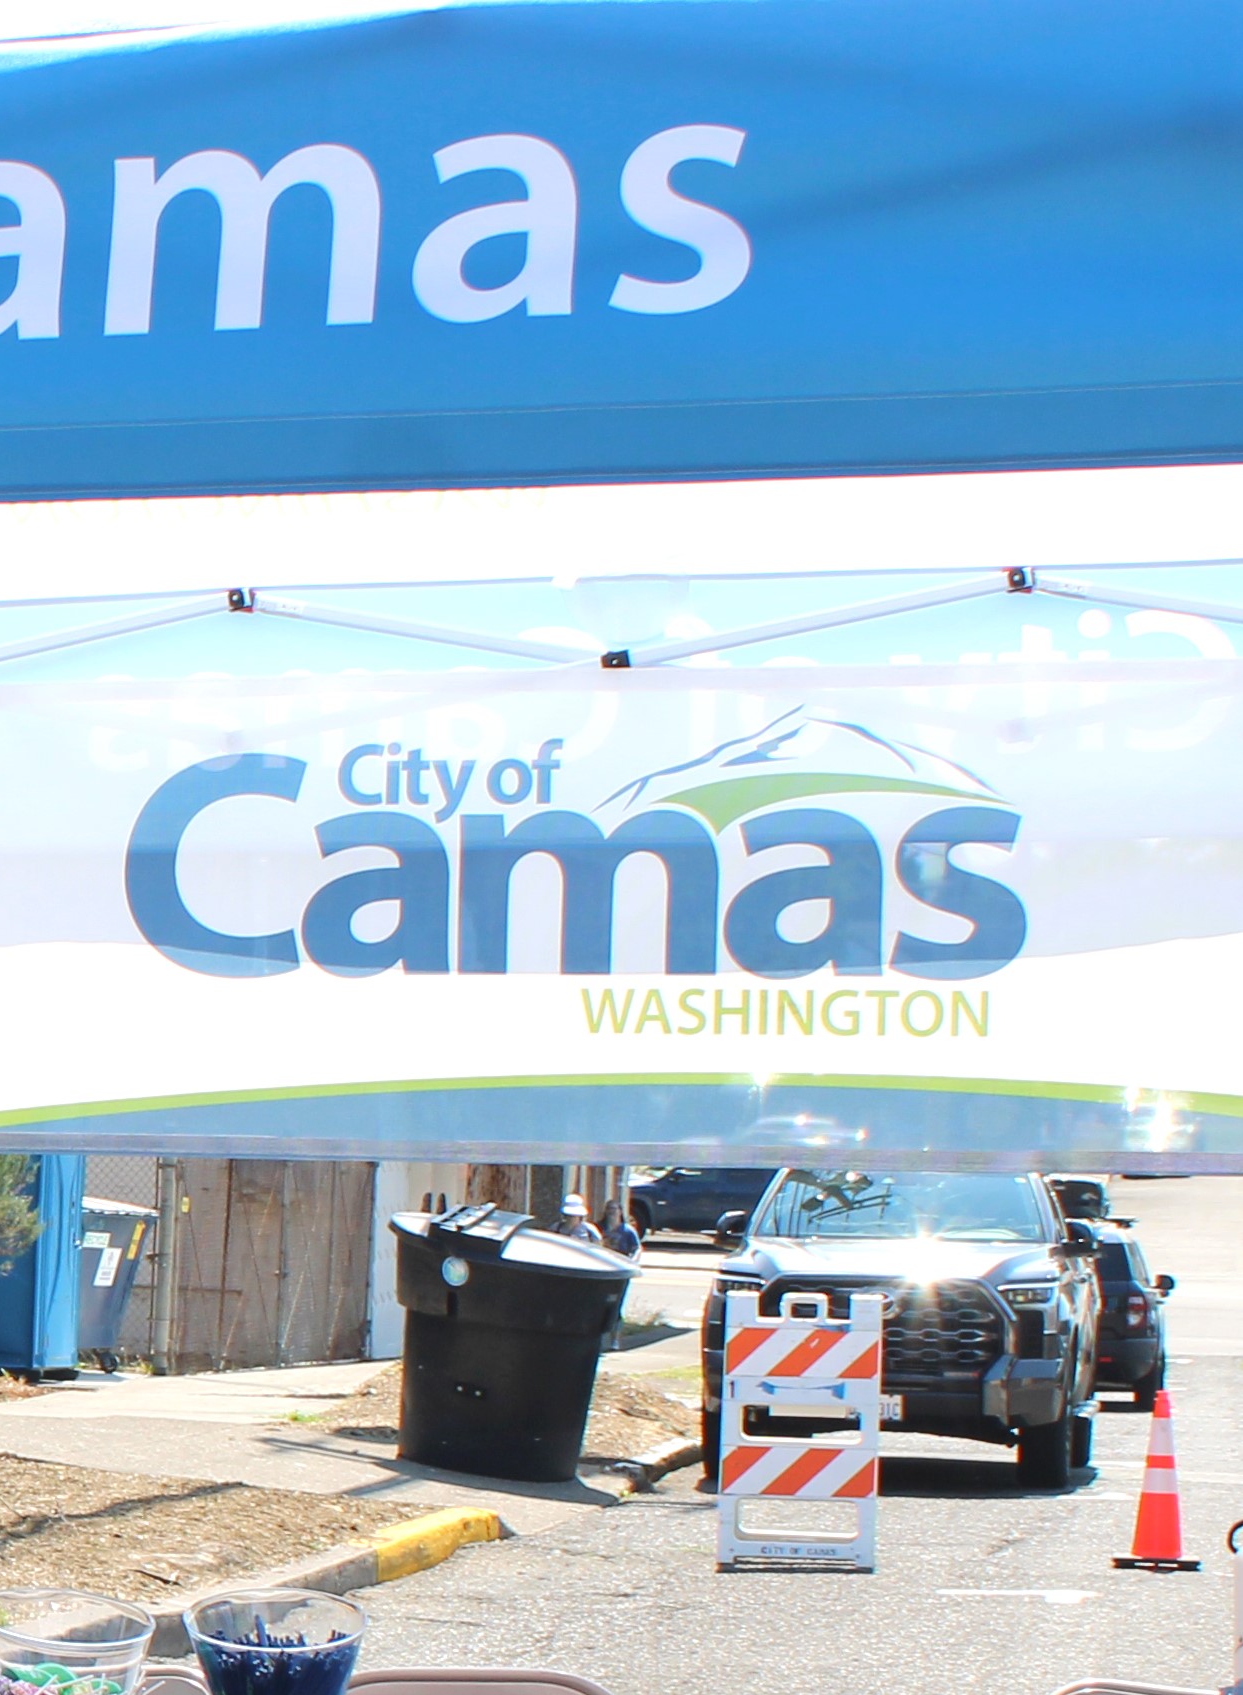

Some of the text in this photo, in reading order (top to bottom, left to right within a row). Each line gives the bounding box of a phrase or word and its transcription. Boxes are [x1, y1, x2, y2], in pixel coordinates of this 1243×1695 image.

[337, 738, 564, 822] City of
[124, 752, 1029, 981] Camas
[581, 988, 991, 1037] WASHINGTON
